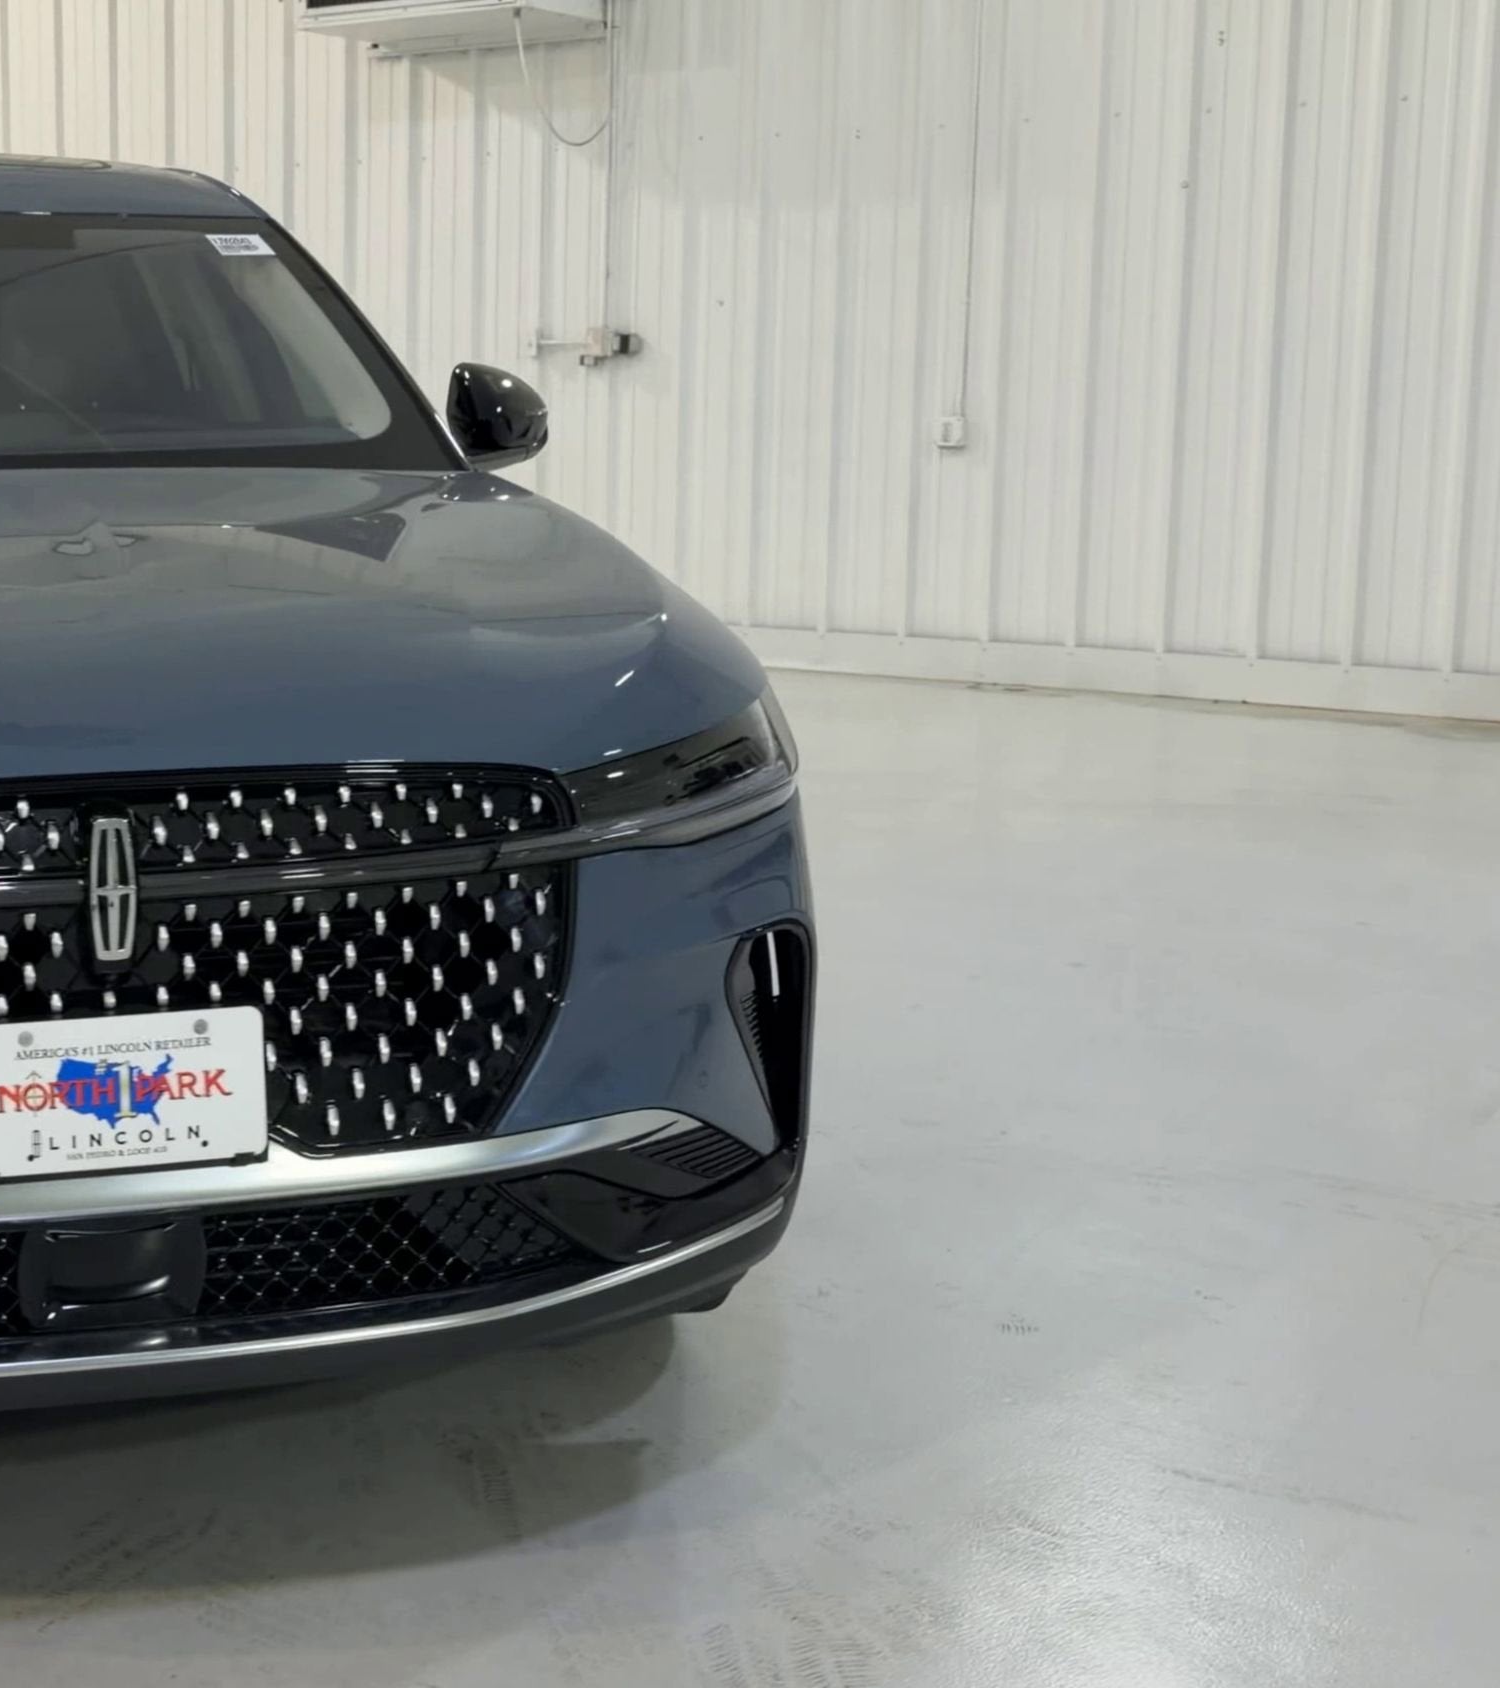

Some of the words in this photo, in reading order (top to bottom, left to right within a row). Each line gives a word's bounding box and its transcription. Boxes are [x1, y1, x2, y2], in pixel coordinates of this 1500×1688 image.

[15, 1047, 79, 1060] AMERICA'S
[81, 1045, 94, 1057] #1
[97, 1040, 153, 1056] LINCOLN
[155, 1037, 211, 1050] RETAILER
[136, 1068, 233, 1101] PARK
[49, 1125, 201, 1150] LINCOLN
